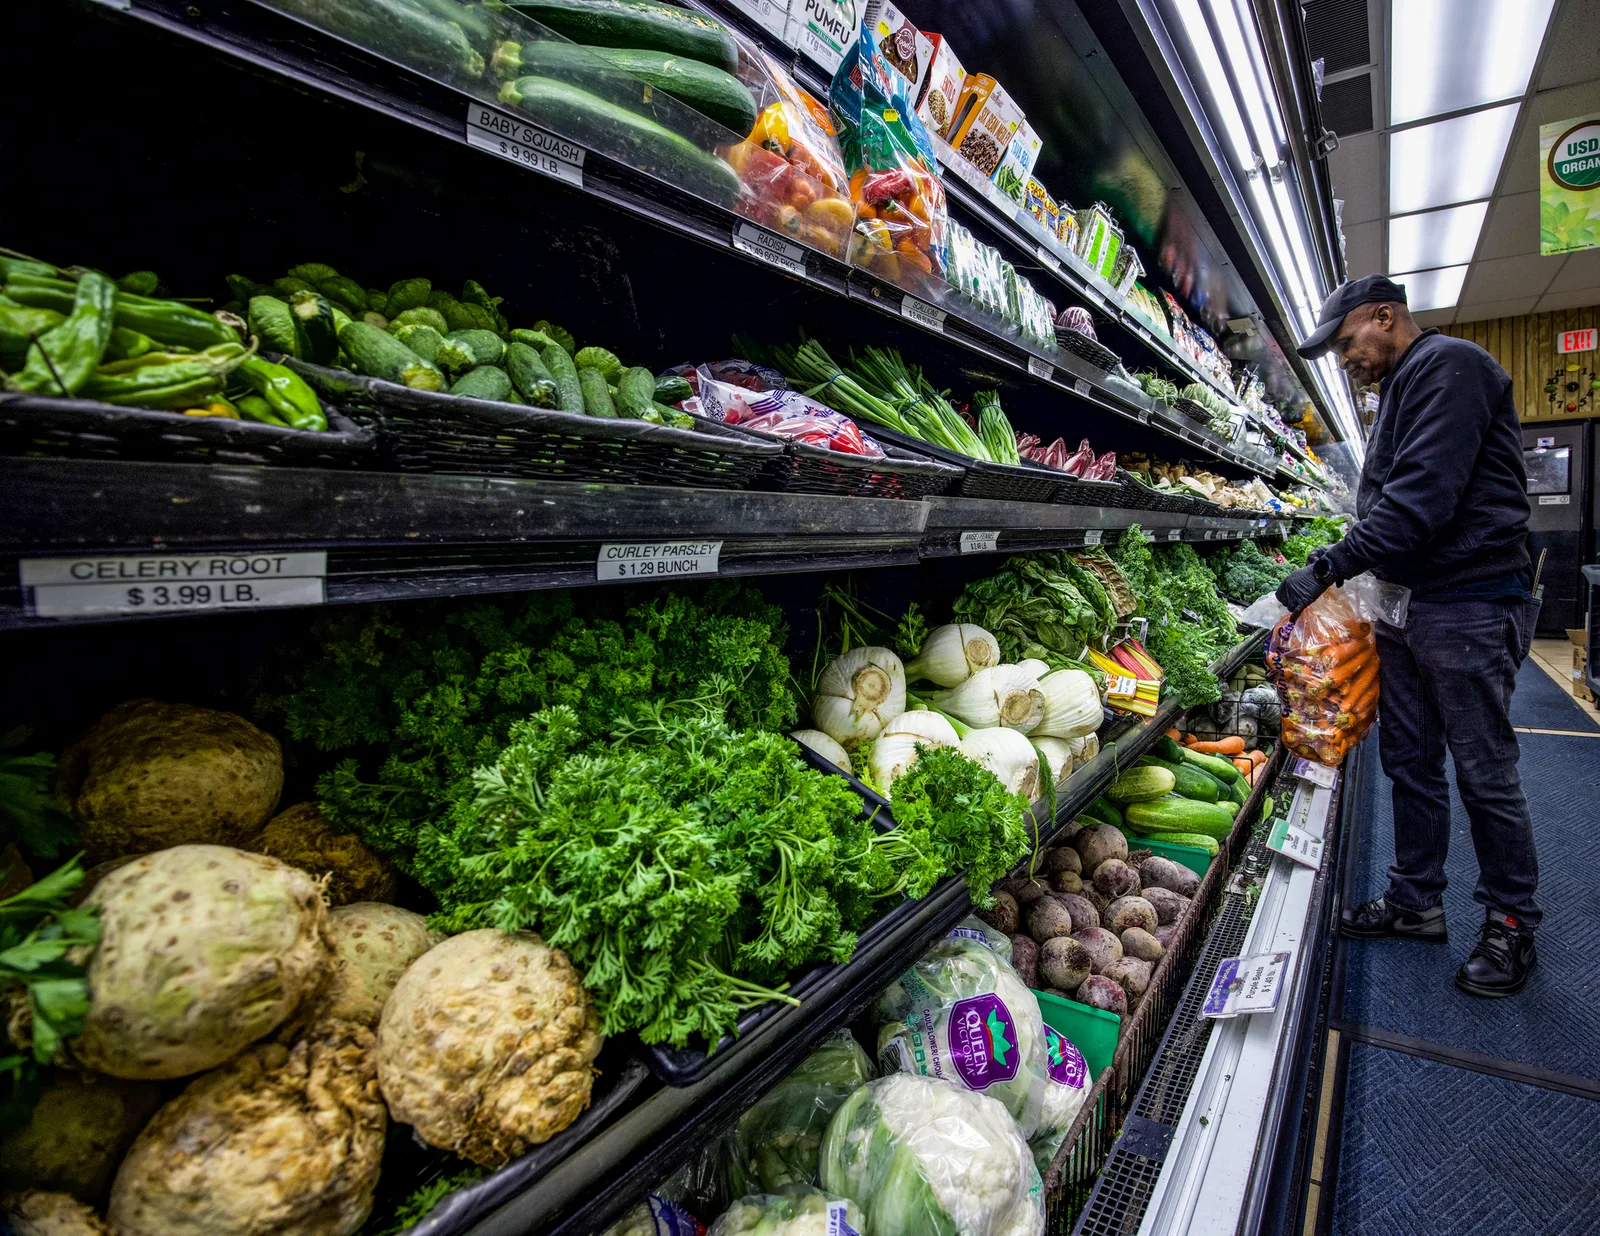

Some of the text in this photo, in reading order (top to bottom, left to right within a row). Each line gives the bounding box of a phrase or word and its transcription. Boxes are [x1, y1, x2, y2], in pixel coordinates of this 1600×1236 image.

[805, 0, 850, 45] PUMFU
[480, 112, 579, 161] BABY SQUASH
[500, 141, 561, 175] $ 9.99 LB.
[1567, 138, 1600, 157] USD
[749, 244, 763, 257] 149
[757, 233, 787, 253] RADISH
[912, 301, 939, 318] SCALLIONS
[1564, 330, 1593, 351] EXIT
[1547, 377, 1559, 386] 10
[1582, 367, 1588, 375] 1
[1588, 372, 1596, 380] 2
[607, 544, 716, 559] CURLEY PARSLEY
[70, 557, 287, 580] CELERY ROOT
[618, 560, 698, 576] $ 1.29 BUNCH
[128, 584, 260, 607] $ 3.99 LB.
[1246, 966, 1264, 999] Purple Beets
[957, 1017, 974, 1075] VICTORIA
[965, 1010, 989, 1075] QUEEN
[1065, 1040, 1077, 1077] QUEE
